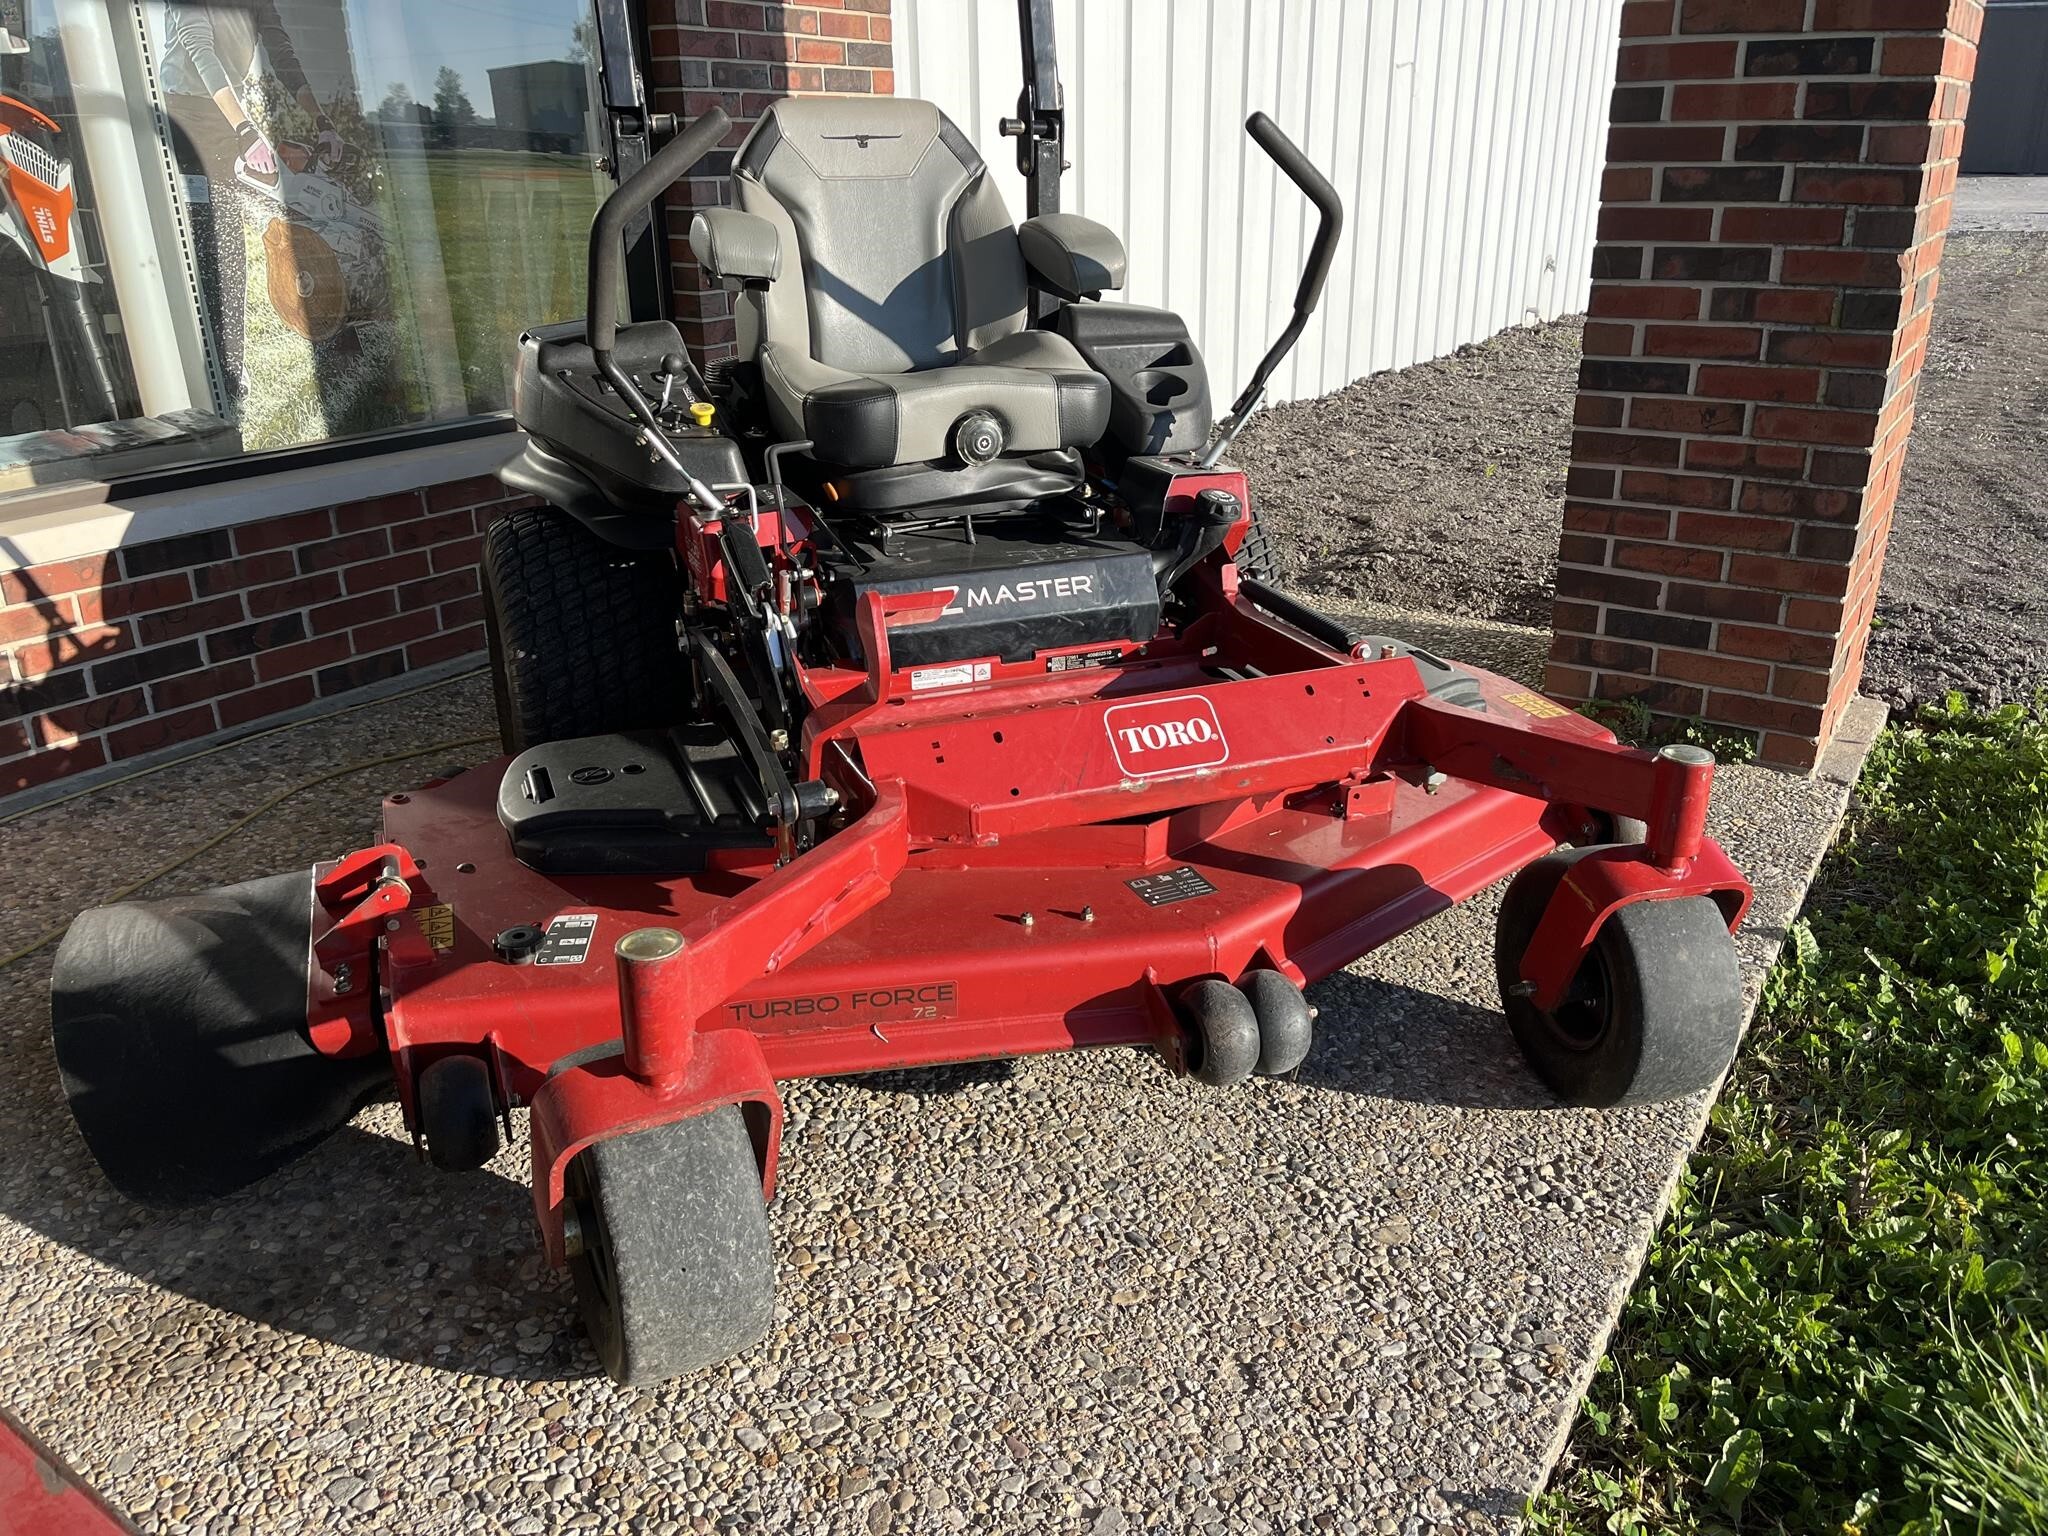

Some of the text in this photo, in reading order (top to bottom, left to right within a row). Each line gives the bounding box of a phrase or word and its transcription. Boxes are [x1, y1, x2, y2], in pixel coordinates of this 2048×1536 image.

[34, 207, 55, 244] STIHL
[967, 575, 1093, 608] MASTER
[1118, 717, 1212, 754] TORO
[729, 984, 953, 1021] TURBO FORCE
[912, 1006, 938, 1018] 72
